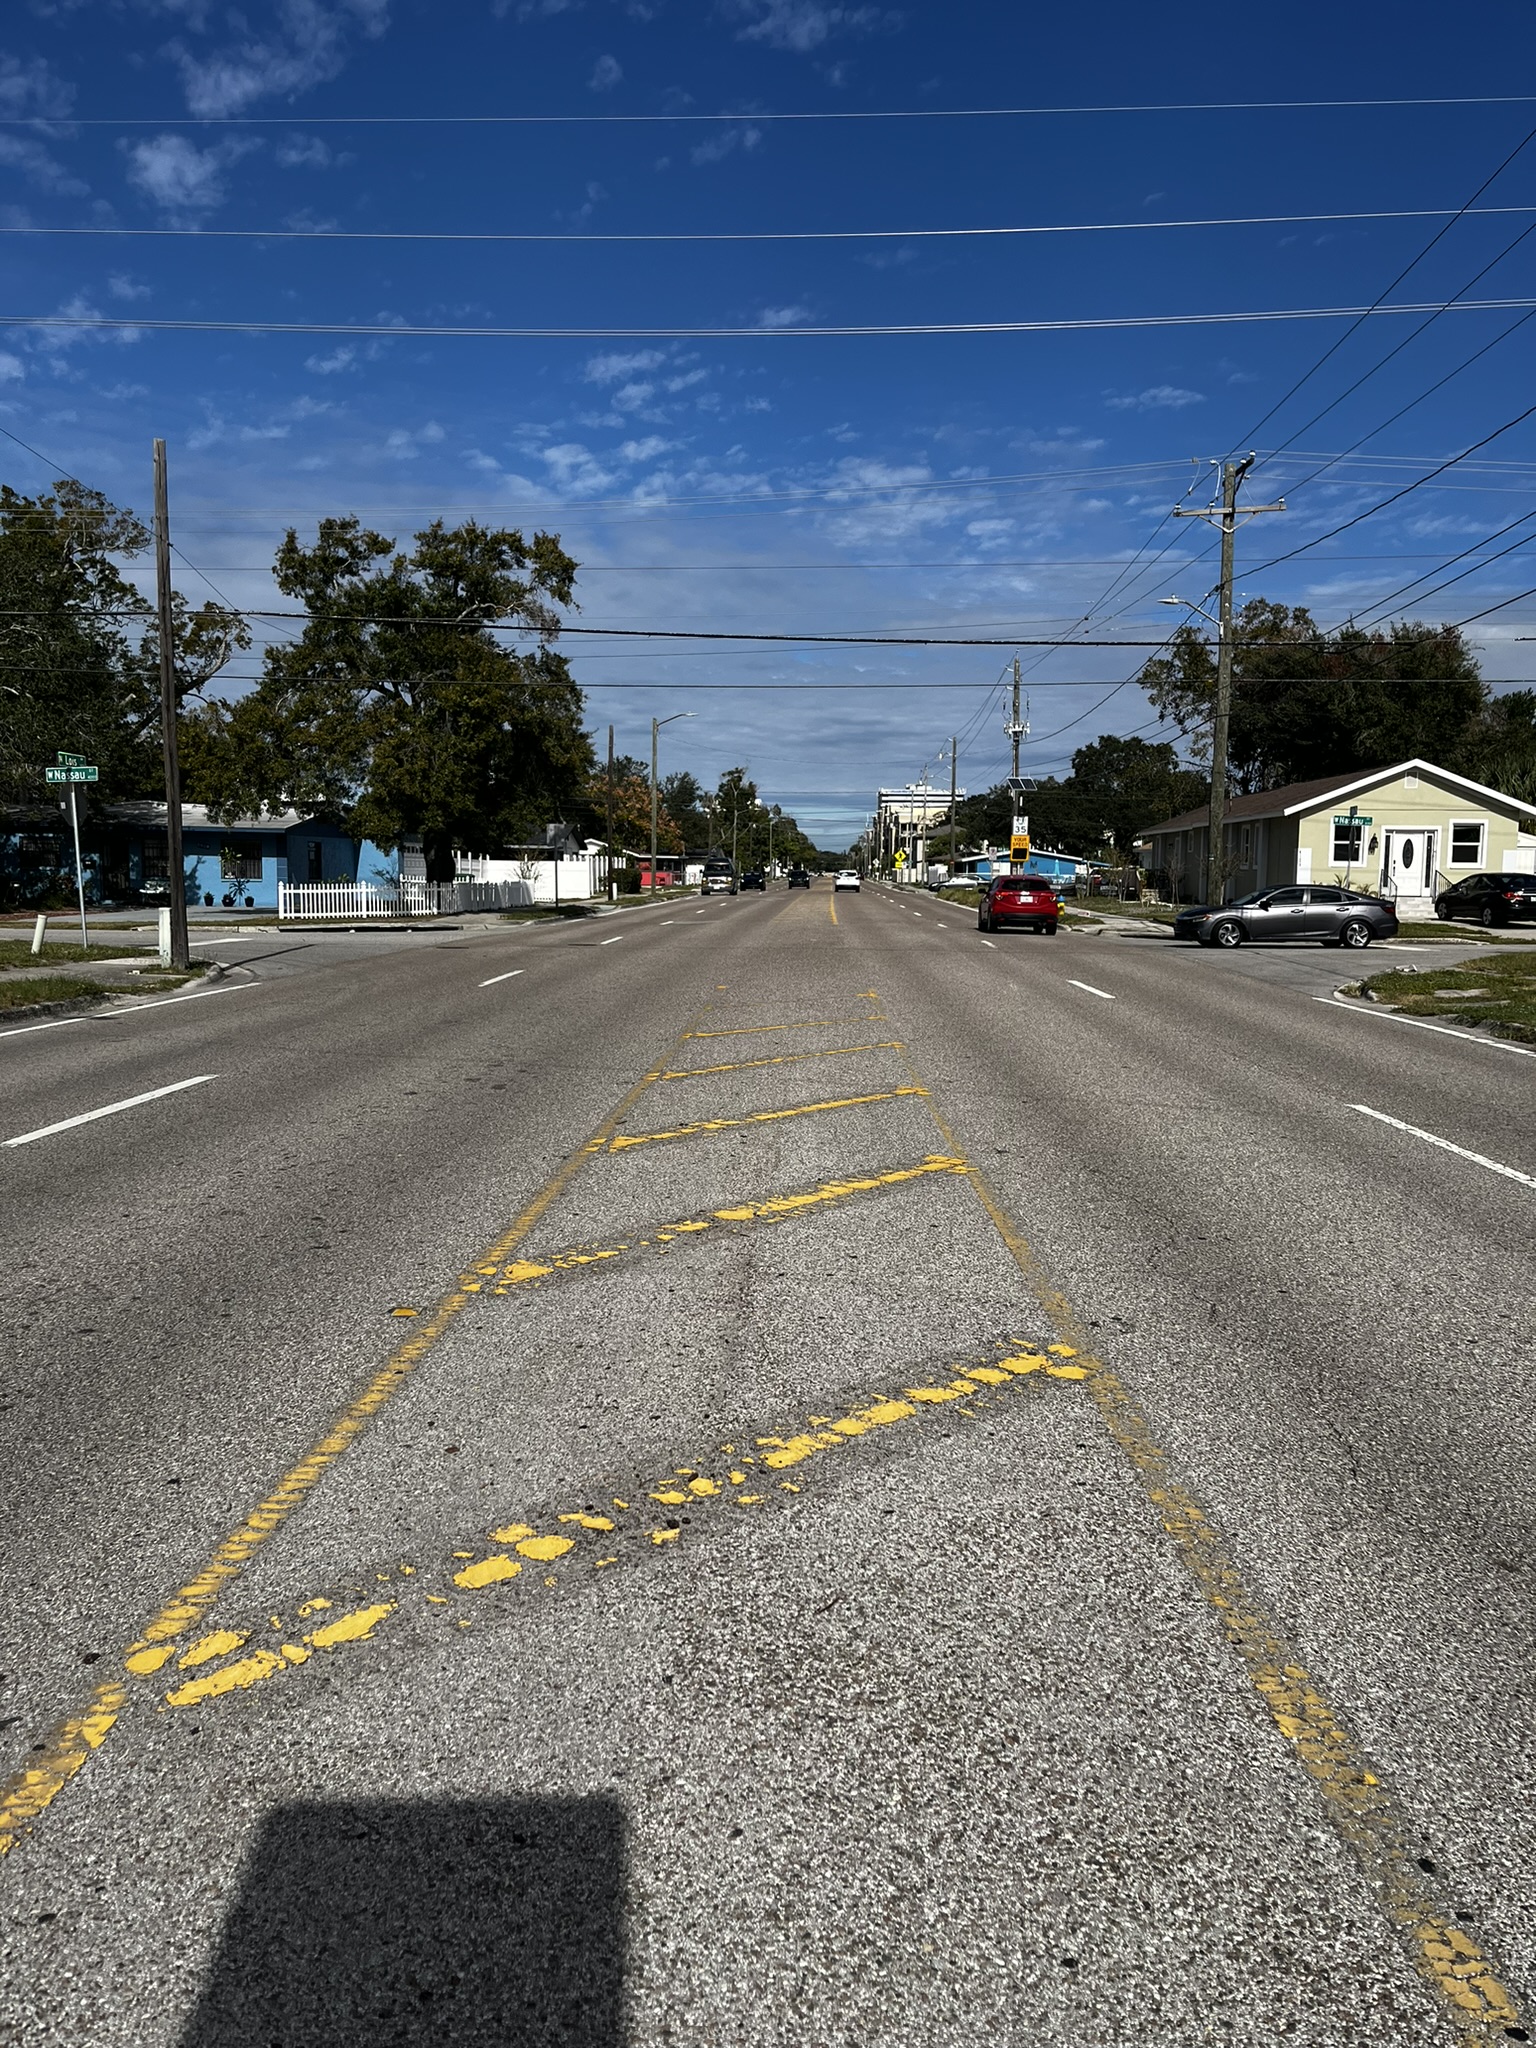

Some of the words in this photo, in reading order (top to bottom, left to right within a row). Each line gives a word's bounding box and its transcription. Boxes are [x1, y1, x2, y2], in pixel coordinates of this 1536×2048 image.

[65, 755, 77, 766] Lois
[48, 771, 53, 779] W
[54, 770, 85, 780] Nassau
[1339, 816, 1364, 825] Nassau
